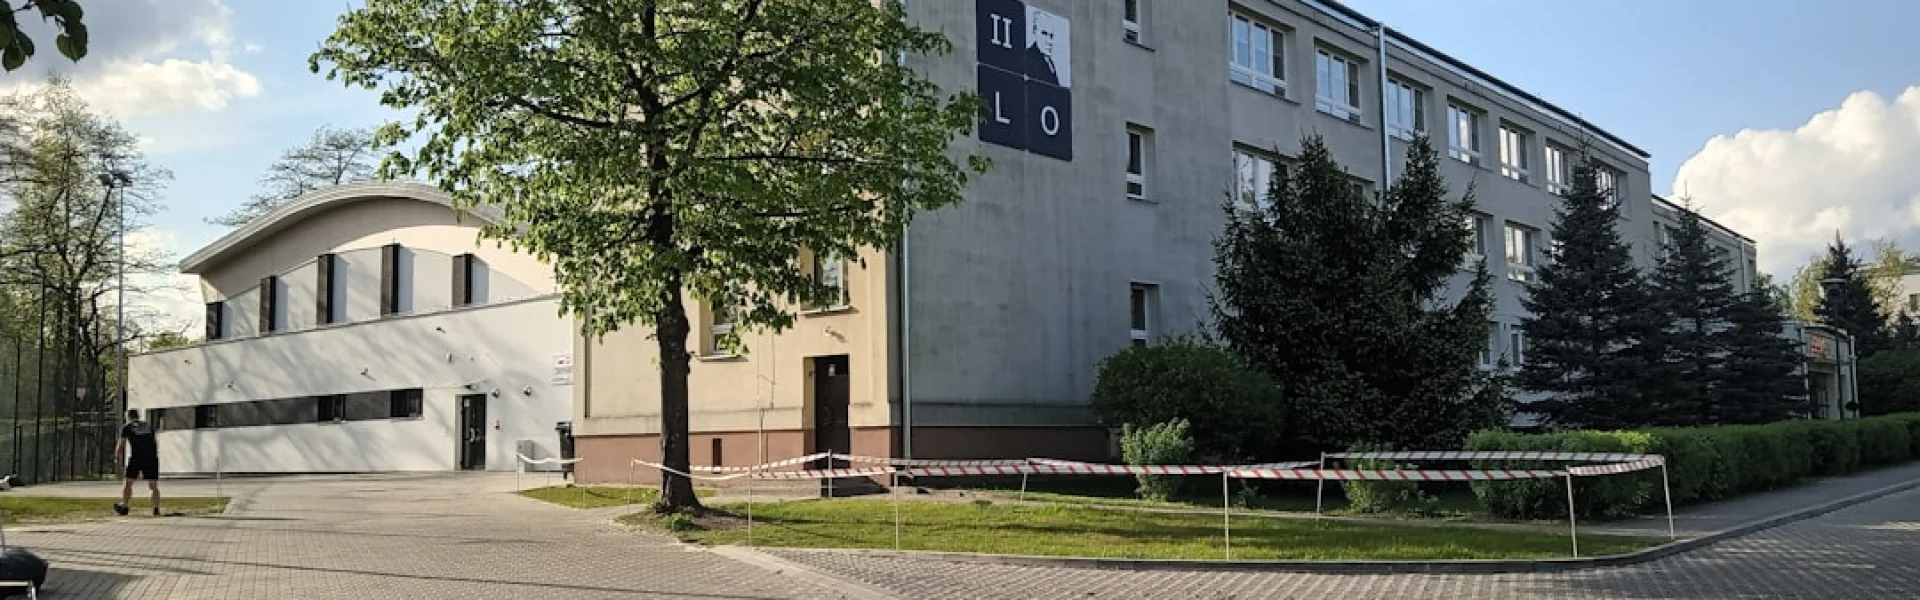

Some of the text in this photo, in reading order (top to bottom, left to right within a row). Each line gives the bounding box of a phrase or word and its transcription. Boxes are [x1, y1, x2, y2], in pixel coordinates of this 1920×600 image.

[989, 13, 1013, 49] II
[994, 91, 1060, 136] L O
